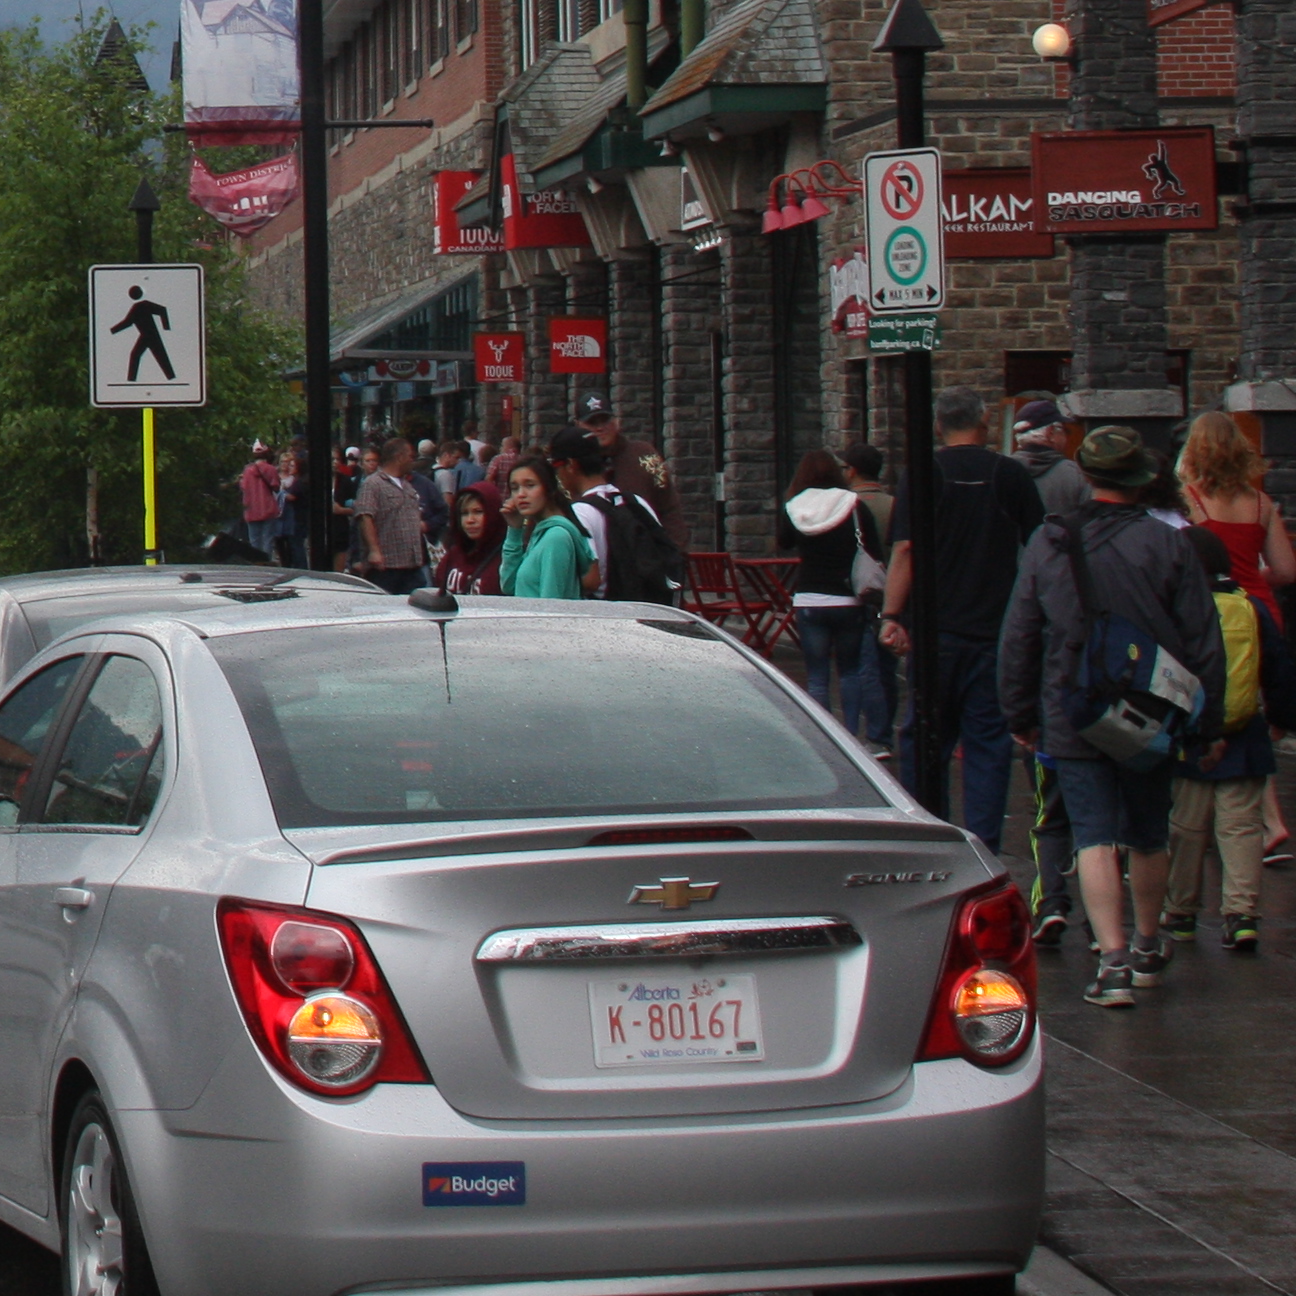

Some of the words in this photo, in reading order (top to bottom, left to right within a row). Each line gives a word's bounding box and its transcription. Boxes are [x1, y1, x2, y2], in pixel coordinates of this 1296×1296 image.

[1047, 190, 1141, 205] DANCING
[535, 203, 570, 214] FACE
[1049, 203, 1201, 221] SASQUATCH
[967, 222, 1034, 233] RESTAURANT
[889, 288, 902, 301] MAX
[912, 287, 924, 299] MIN
[869, 318, 895, 330] Looking
[567, 334, 584, 343] THE
[553, 341, 584, 350] NORTH
[561, 349, 584, 358] FACE
[484, 365, 514, 378] TOQUE
[844, 871, 924, 888] SONIC
[627, 982, 681, 1002] Alberta
[607, 999, 743, 1044] K-80167
[640, 1048, 660, 1059] Wild
[662, 1047, 683, 1057] Rose
[686, 1046, 719, 1057] Country
[451, 1175, 516, 1197] Budget
